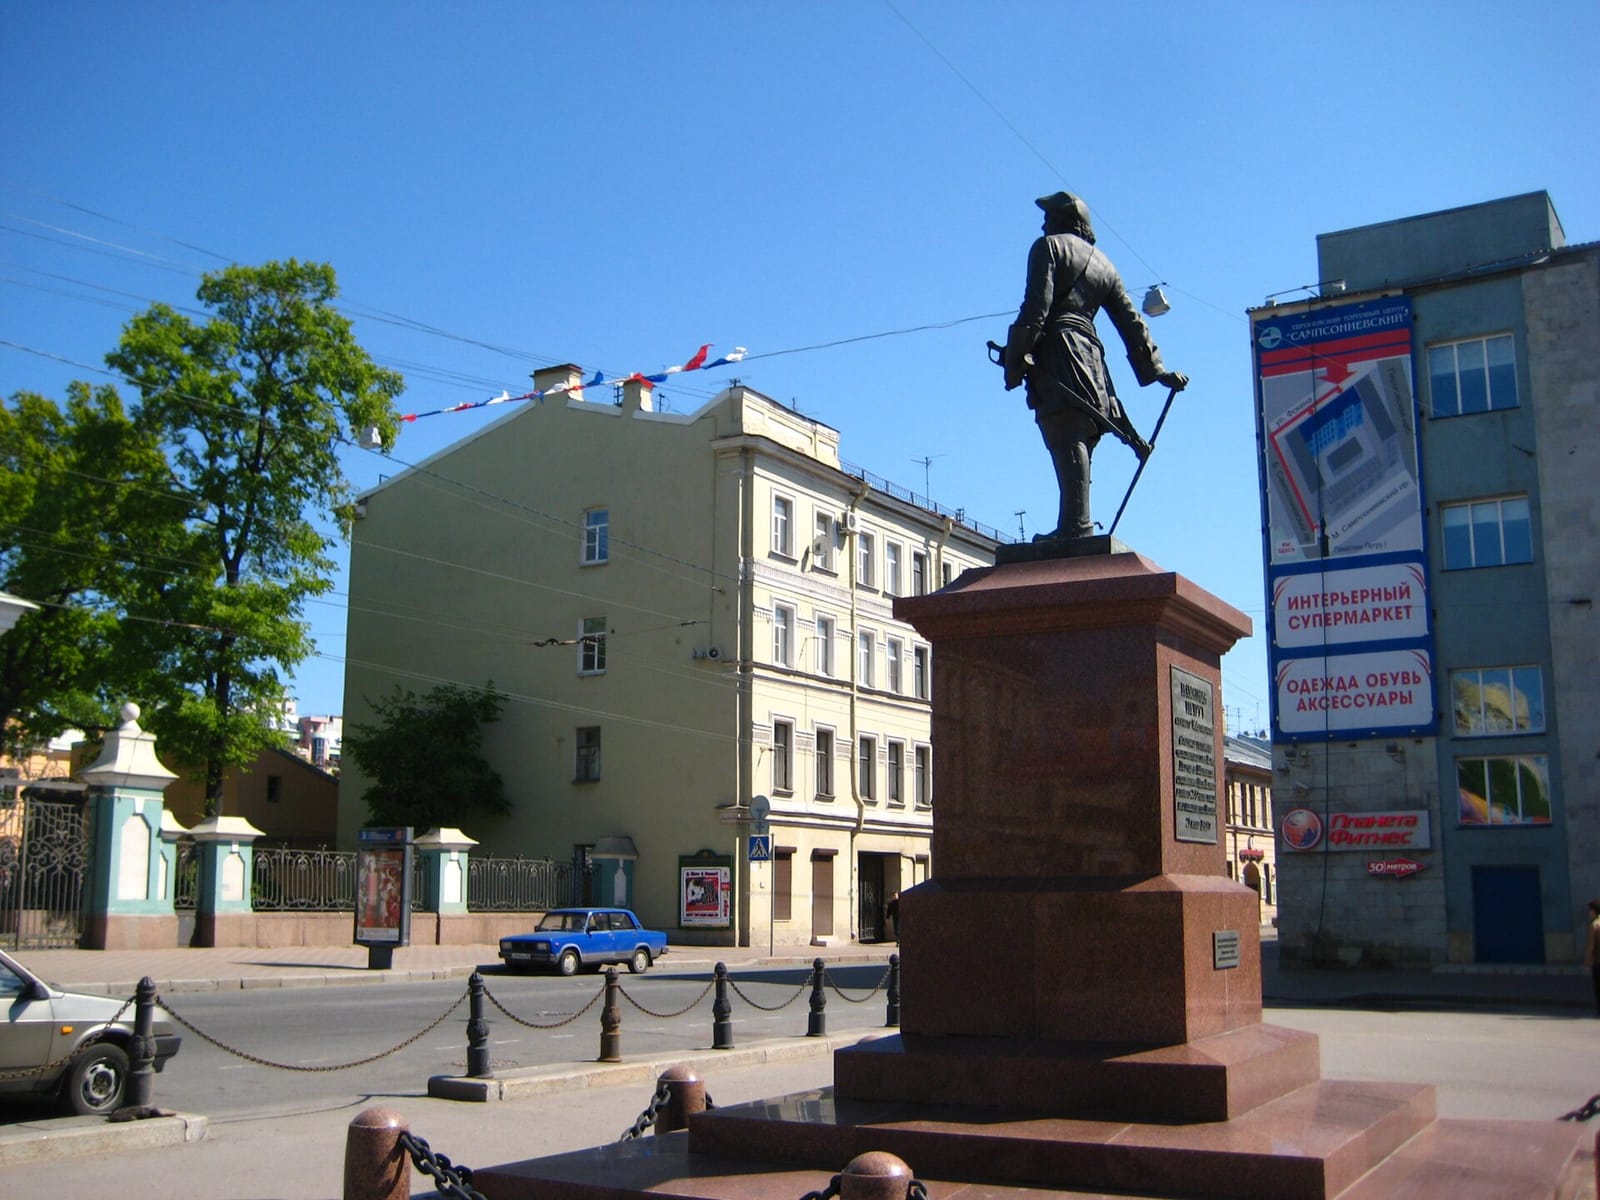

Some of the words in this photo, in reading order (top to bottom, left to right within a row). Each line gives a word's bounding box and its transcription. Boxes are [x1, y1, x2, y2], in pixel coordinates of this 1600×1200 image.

[1287, 581, 1411, 611] ИНТЕРЬЕРНЫЙ
[1288, 605, 1413, 630] СУПЕРМАРКЕТ
[1286, 675, 1359, 695] ОДЕЖДА
[1366, 671, 1422, 688] ОБУВЬ
[1296, 690, 1413, 712] АКСЕССУАРЫ
[1330, 814, 1418, 829] Планета
[1329, 830, 1413, 846] Фитнес
